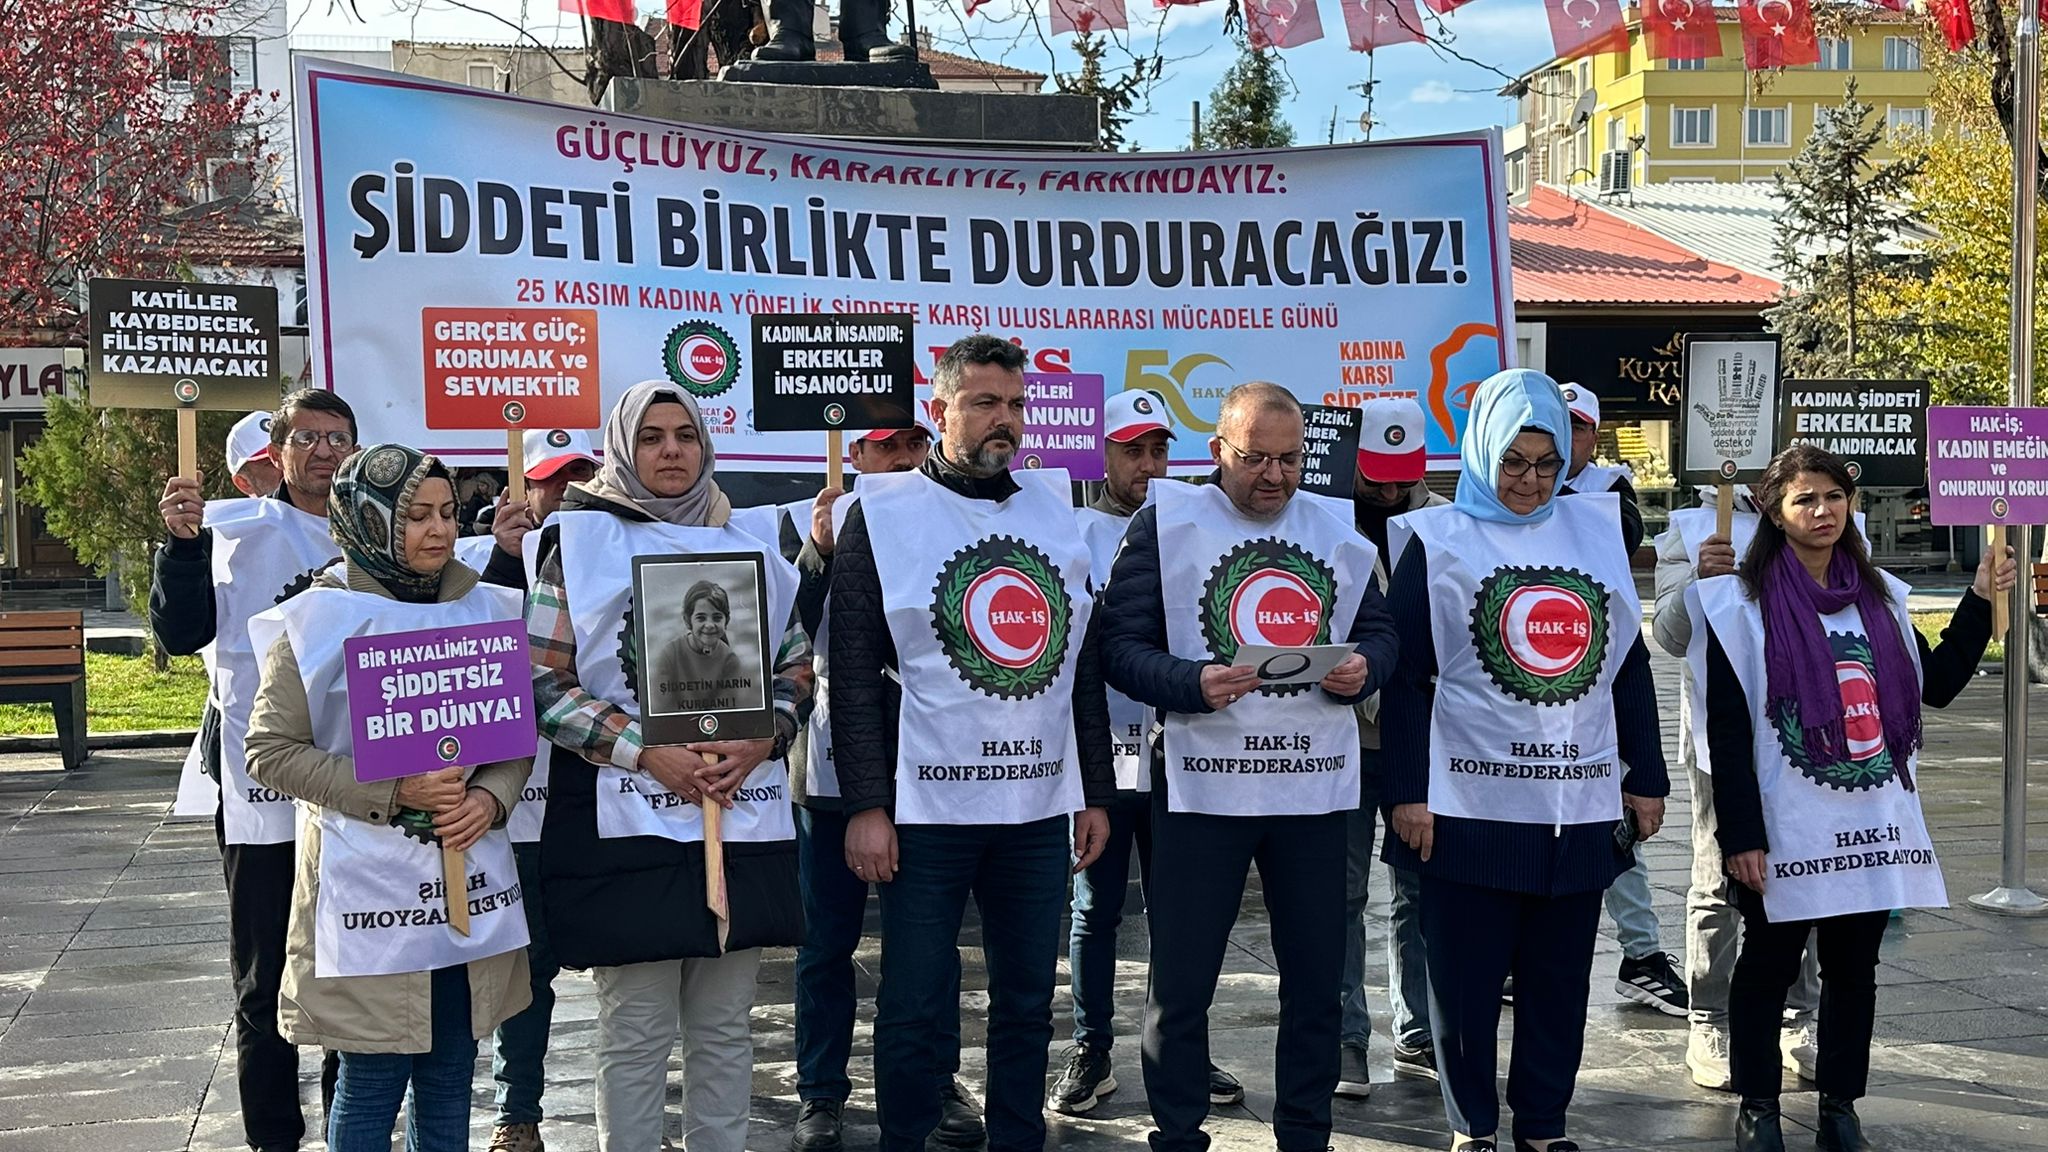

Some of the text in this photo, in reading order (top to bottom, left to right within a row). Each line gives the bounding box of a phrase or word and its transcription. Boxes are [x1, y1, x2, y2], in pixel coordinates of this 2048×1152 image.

[556, 120, 1287, 196] GÜÇLÜYÜZ, KARARLIYIZ, FARKINDAYIZ:
[350, 162, 1469, 288] ŞİDDETİ BİRLİKTE DURDURACAĞIZ!
[131, 289, 237, 311] KATİLLER
[517, 279, 545, 302] 25
[555, 280, 629, 307] KASIM
[639, 286, 723, 313] KADINA
[928, 303, 990, 332] KARŞI
[998, 306, 1155, 329] ULUSLARARASI
[1163, 304, 1274, 329] MÜCADELE
[1282, 303, 1338, 328] GÜNÜ
[109, 312, 260, 335] KAYBEDECEK,
[435, 317, 586, 346] GERÇEK GÜÇ;
[762, 321, 904, 343] KADINLAR İNSANDIR;
[102, 330, 267, 355] FİLİSTİN HALKI
[1340, 341, 1406, 360] KADINA
[103, 355, 268, 377] KAZANACAK!
[435, 349, 588, 369] KORUMAK ve
[783, 349, 884, 368] ERKEKLER
[444, 372, 580, 396] SEVMEKTİR
[775, 370, 893, 394] İNSANOĞLU!
[1341, 365, 1393, 387] KARŞI
[1791, 389, 1921, 410] KADINA ŞİDDETİ
[1023, 406, 1095, 426] ANUNU
[1312, 409, 1354, 427] FİZİKİ,
[1796, 413, 1913, 432] ERKEKLER
[1970, 412, 2023, 436] HAK-İŞ:
[1046, 434, 1095, 449] ALINSIN
[1713, 436, 1753, 448] destek ol
[1937, 436, 2048, 458] KADIN EMEĞİN
[1303, 472, 1332, 486] SON
[1990, 463, 2007, 475] ve
[1939, 480, 2005, 496] ONURUNU
[991, 607, 1046, 626] HAK-İŞ
[1258, 608, 1319, 626] HAK-İŞ
[1528, 619, 1587, 637] HAK-İŞ
[358, 636, 518, 669] BİR HAYALİMİZ VAR:
[381, 658, 503, 705] ŞİDDETSİZ
[660, 676, 751, 695] ŞİDDETİN NARİN
[366, 696, 521, 741] BİR DÜNYA!
[1844, 701, 1880, 719] AK-İŞ
[982, 736, 1043, 758] HAK-İŞ
[1244, 732, 1311, 754] HAK-İŞ
[1510, 740, 1579, 762] HAK-İŞ
[918, 758, 1063, 781] KONFEDERASYON
[1183, 754, 1345, 774] KONFEDERASYONU
[1449, 757, 1612, 780] KONFEDERASYONU
[1774, 849, 1937, 879] KONFEDERAYON
